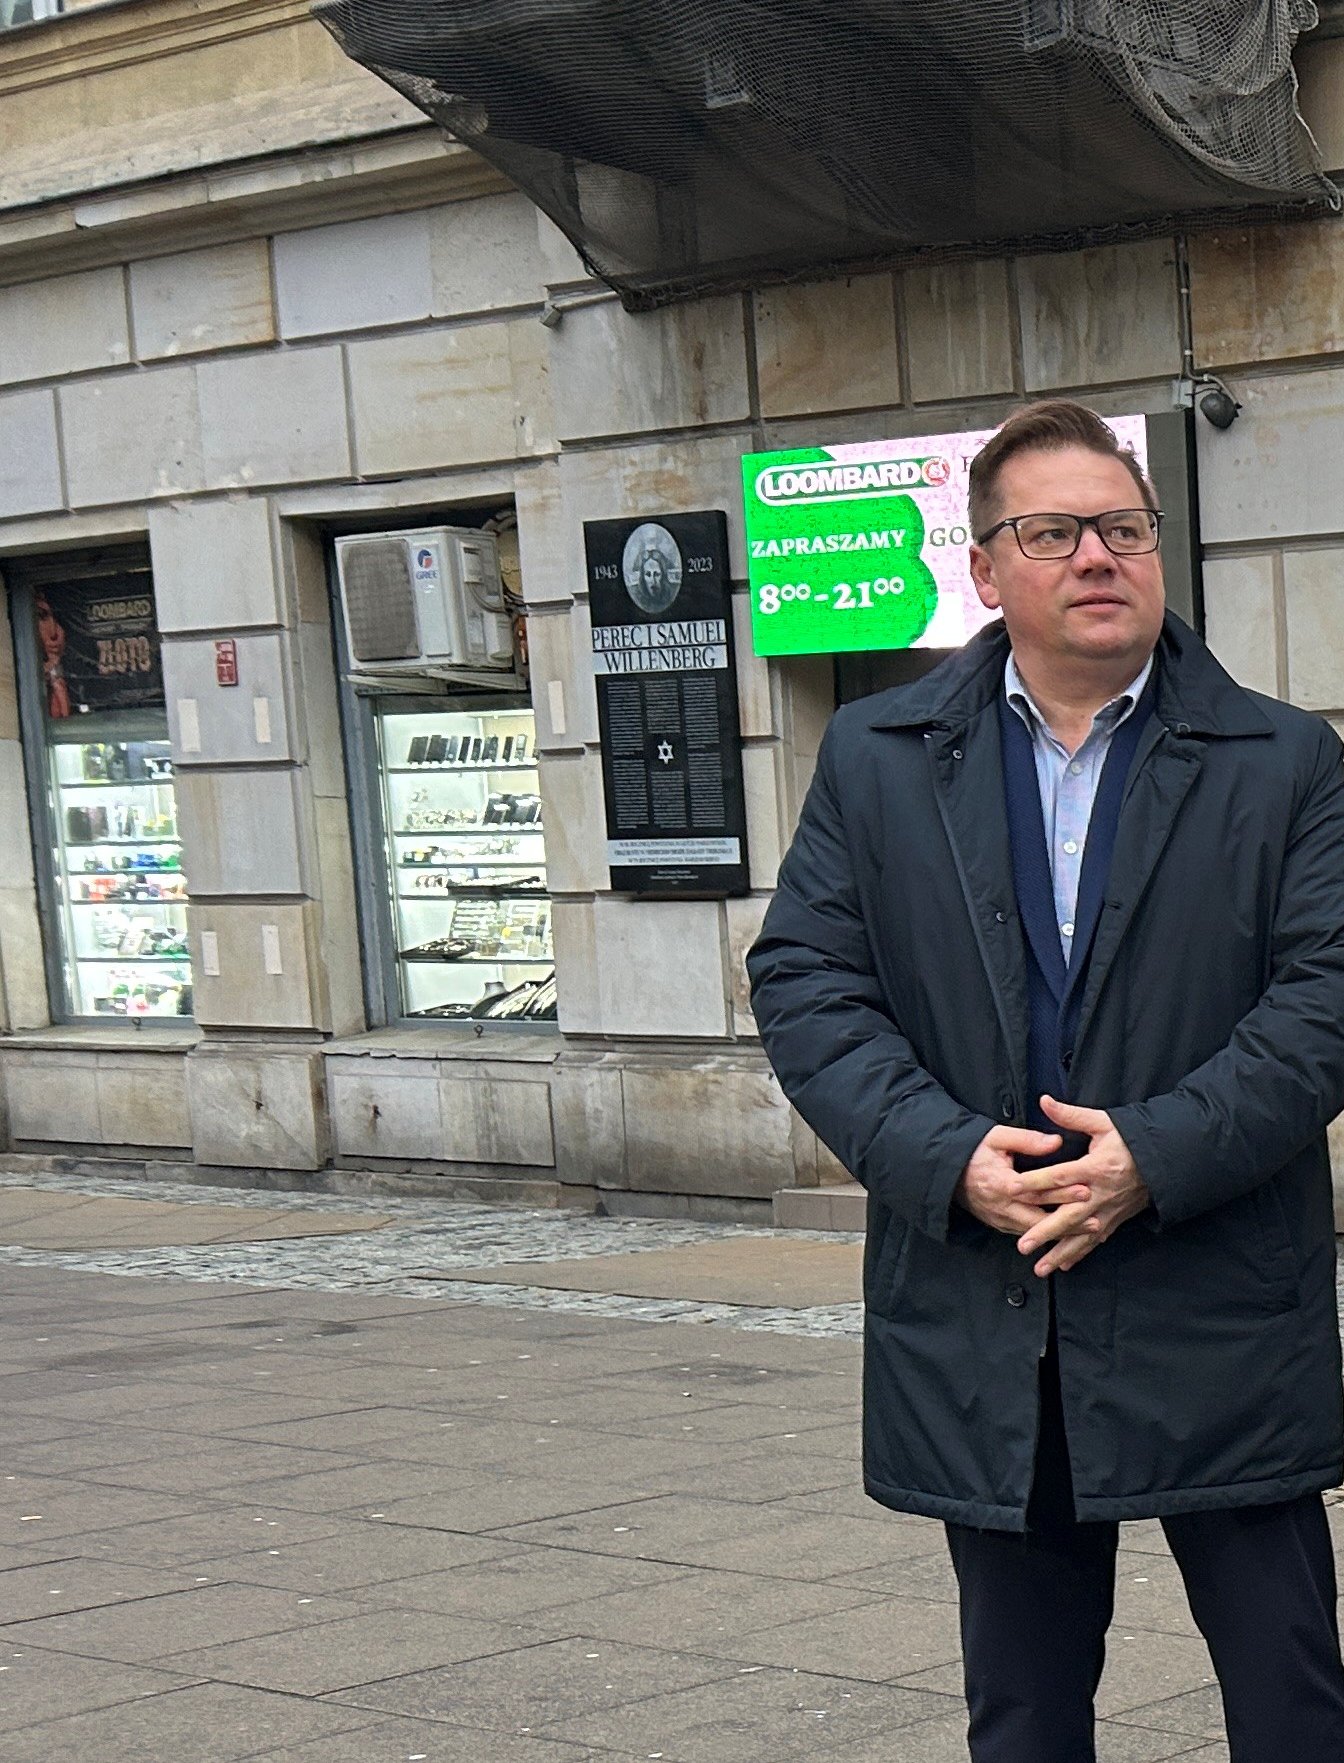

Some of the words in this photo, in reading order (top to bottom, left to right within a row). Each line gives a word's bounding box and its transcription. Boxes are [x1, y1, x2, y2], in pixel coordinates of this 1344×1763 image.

[763, 461, 921, 498] LOOMBARD
[751, 528, 907, 559] ZAPRASZAMY
[415, 570, 439, 581] GREE
[593, 564, 619, 581] 1943
[687, 556, 713, 574] 2023
[592, 626, 643, 649] PEREC
[646, 625, 653, 647] I
[656, 620, 727, 645] SAMUEL
[603, 646, 717, 673] WILLENBERG
